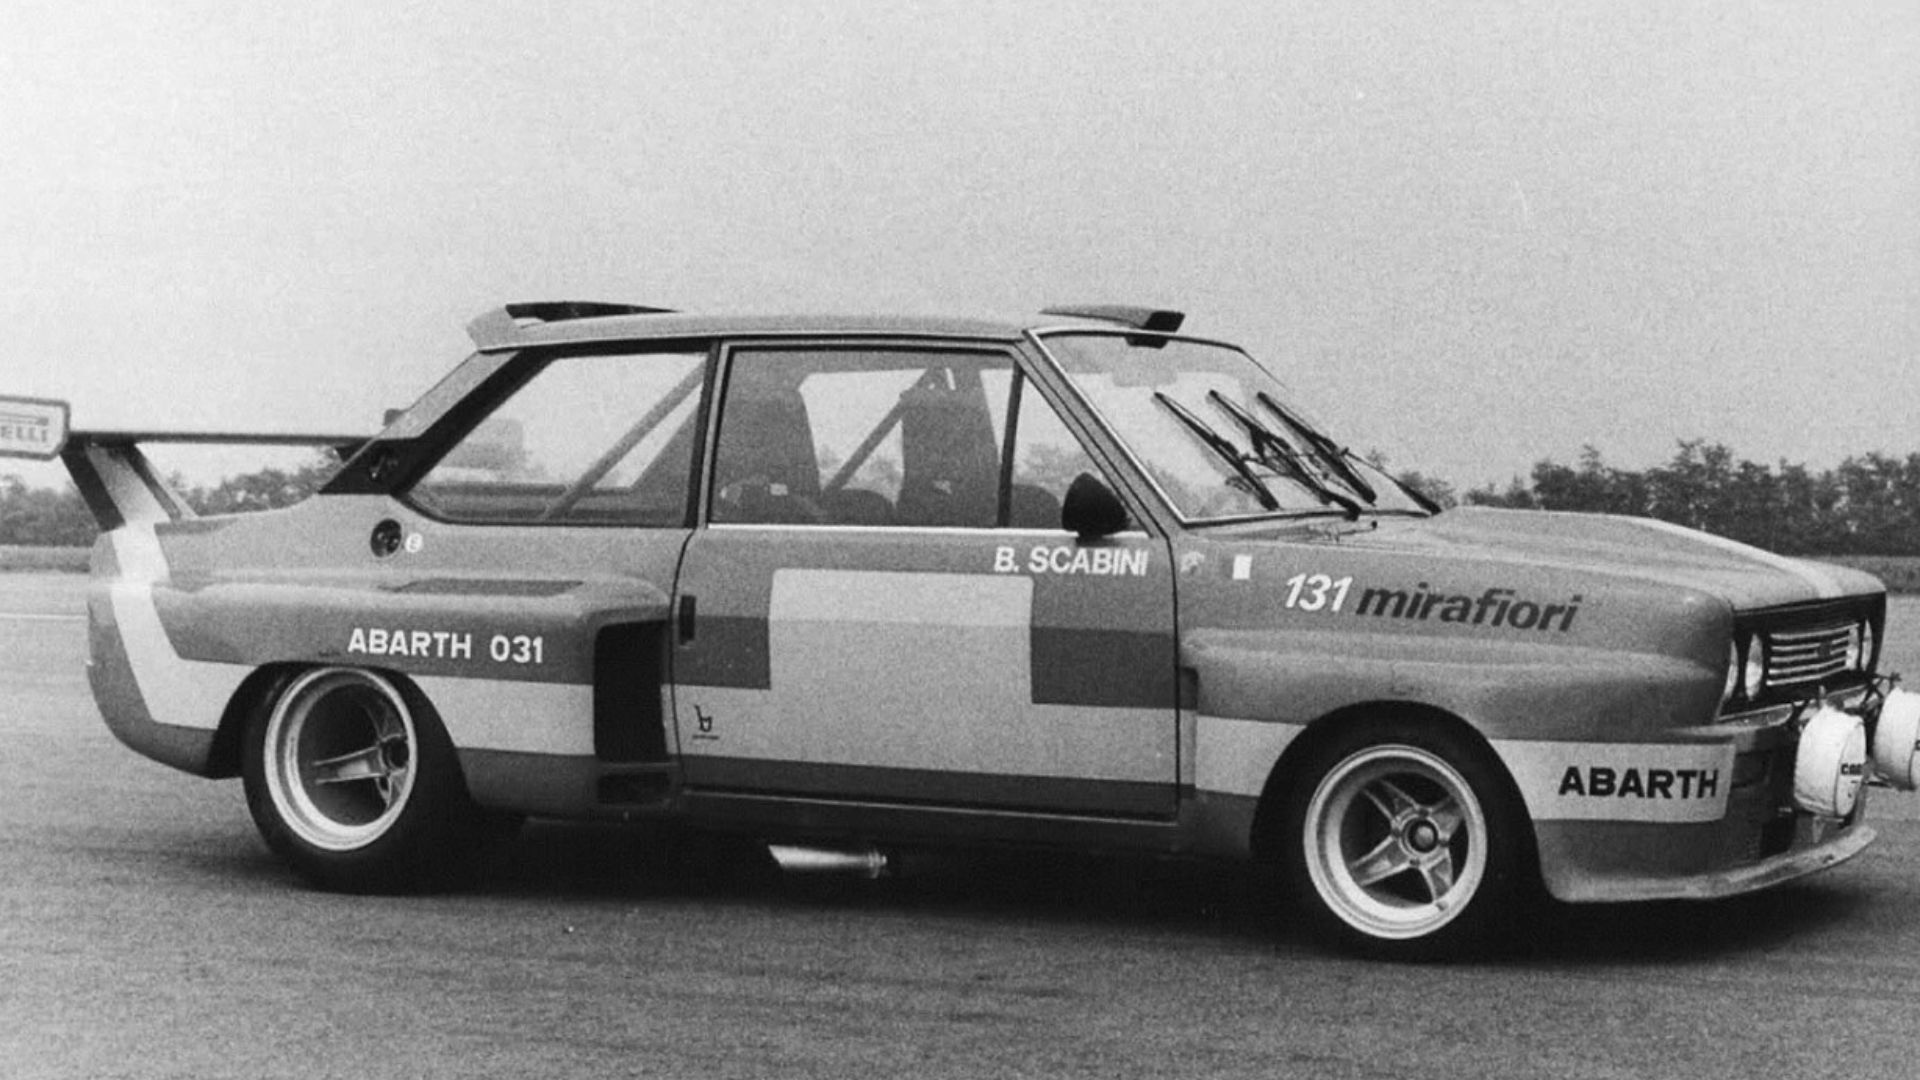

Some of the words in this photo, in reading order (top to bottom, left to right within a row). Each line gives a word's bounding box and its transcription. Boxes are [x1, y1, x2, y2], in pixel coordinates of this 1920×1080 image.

[993, 545, 1020, 573] B.
[1027, 545, 1149, 577] SCABINI
[1285, 573, 1353, 612] 131
[1355, 582, 1582, 633] mirafiori
[347, 627, 471, 659] ABARTH
[489, 634, 543, 664] 031
[1558, 766, 1720, 800] ABARTH
